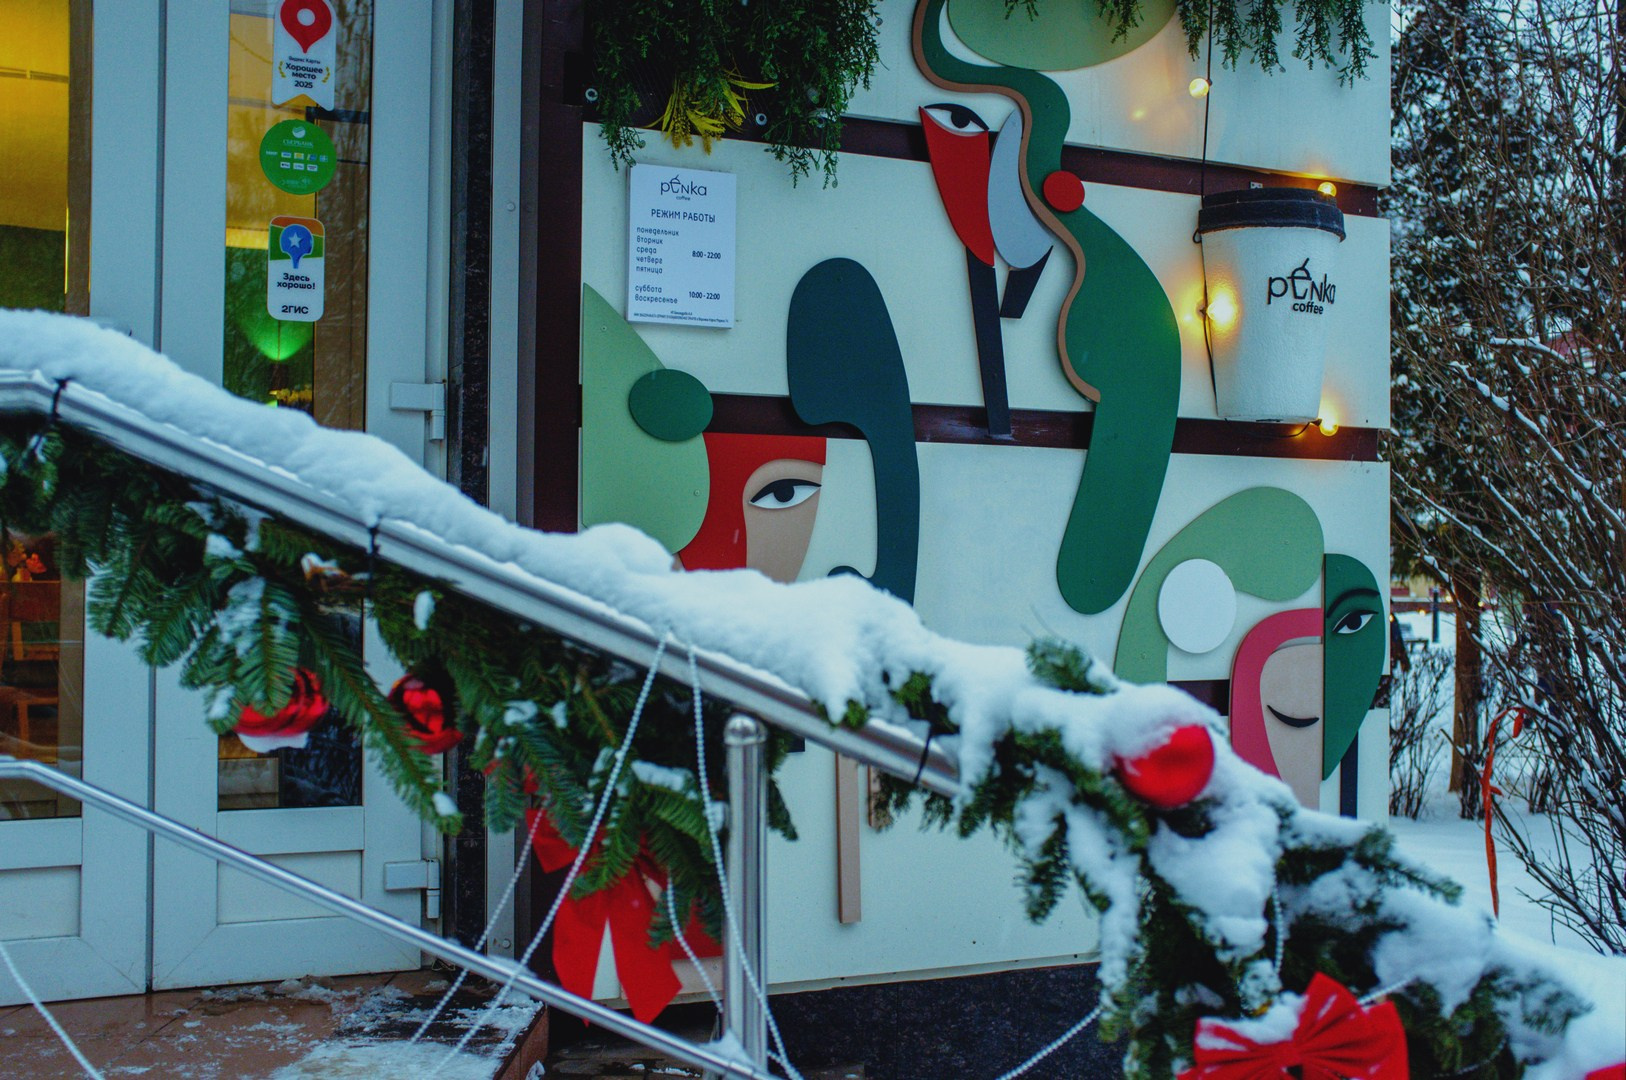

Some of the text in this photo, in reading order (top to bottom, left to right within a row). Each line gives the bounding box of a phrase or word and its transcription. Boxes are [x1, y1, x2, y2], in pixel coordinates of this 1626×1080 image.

[285, 63, 323, 74] Хорошее
[292, 72, 316, 80] место
[294, 80, 313, 89] 2025
[651, 208, 716, 223] РЕЖИМ РАБОТЫ
[636, 226, 680, 236] понедельник
[636, 236, 663, 245] вторник
[636, 246, 657, 254] среда
[692, 250, 704, 258] 8:00
[707, 251, 721, 259] 22:00
[636, 256, 663, 265] четверг
[636, 265, 663, 274] пятница
[283, 272, 310, 282] Здесь
[277, 281, 316, 290] хорошо!
[635, 284, 662, 294] суббота
[635, 294, 678, 304] воскресенье
[689, 291, 702, 299] 10:00
[706, 292, 720, 300] 22:00
[281, 305, 309, 315] 2ГИС
[1292, 301, 1324, 315] coffee
